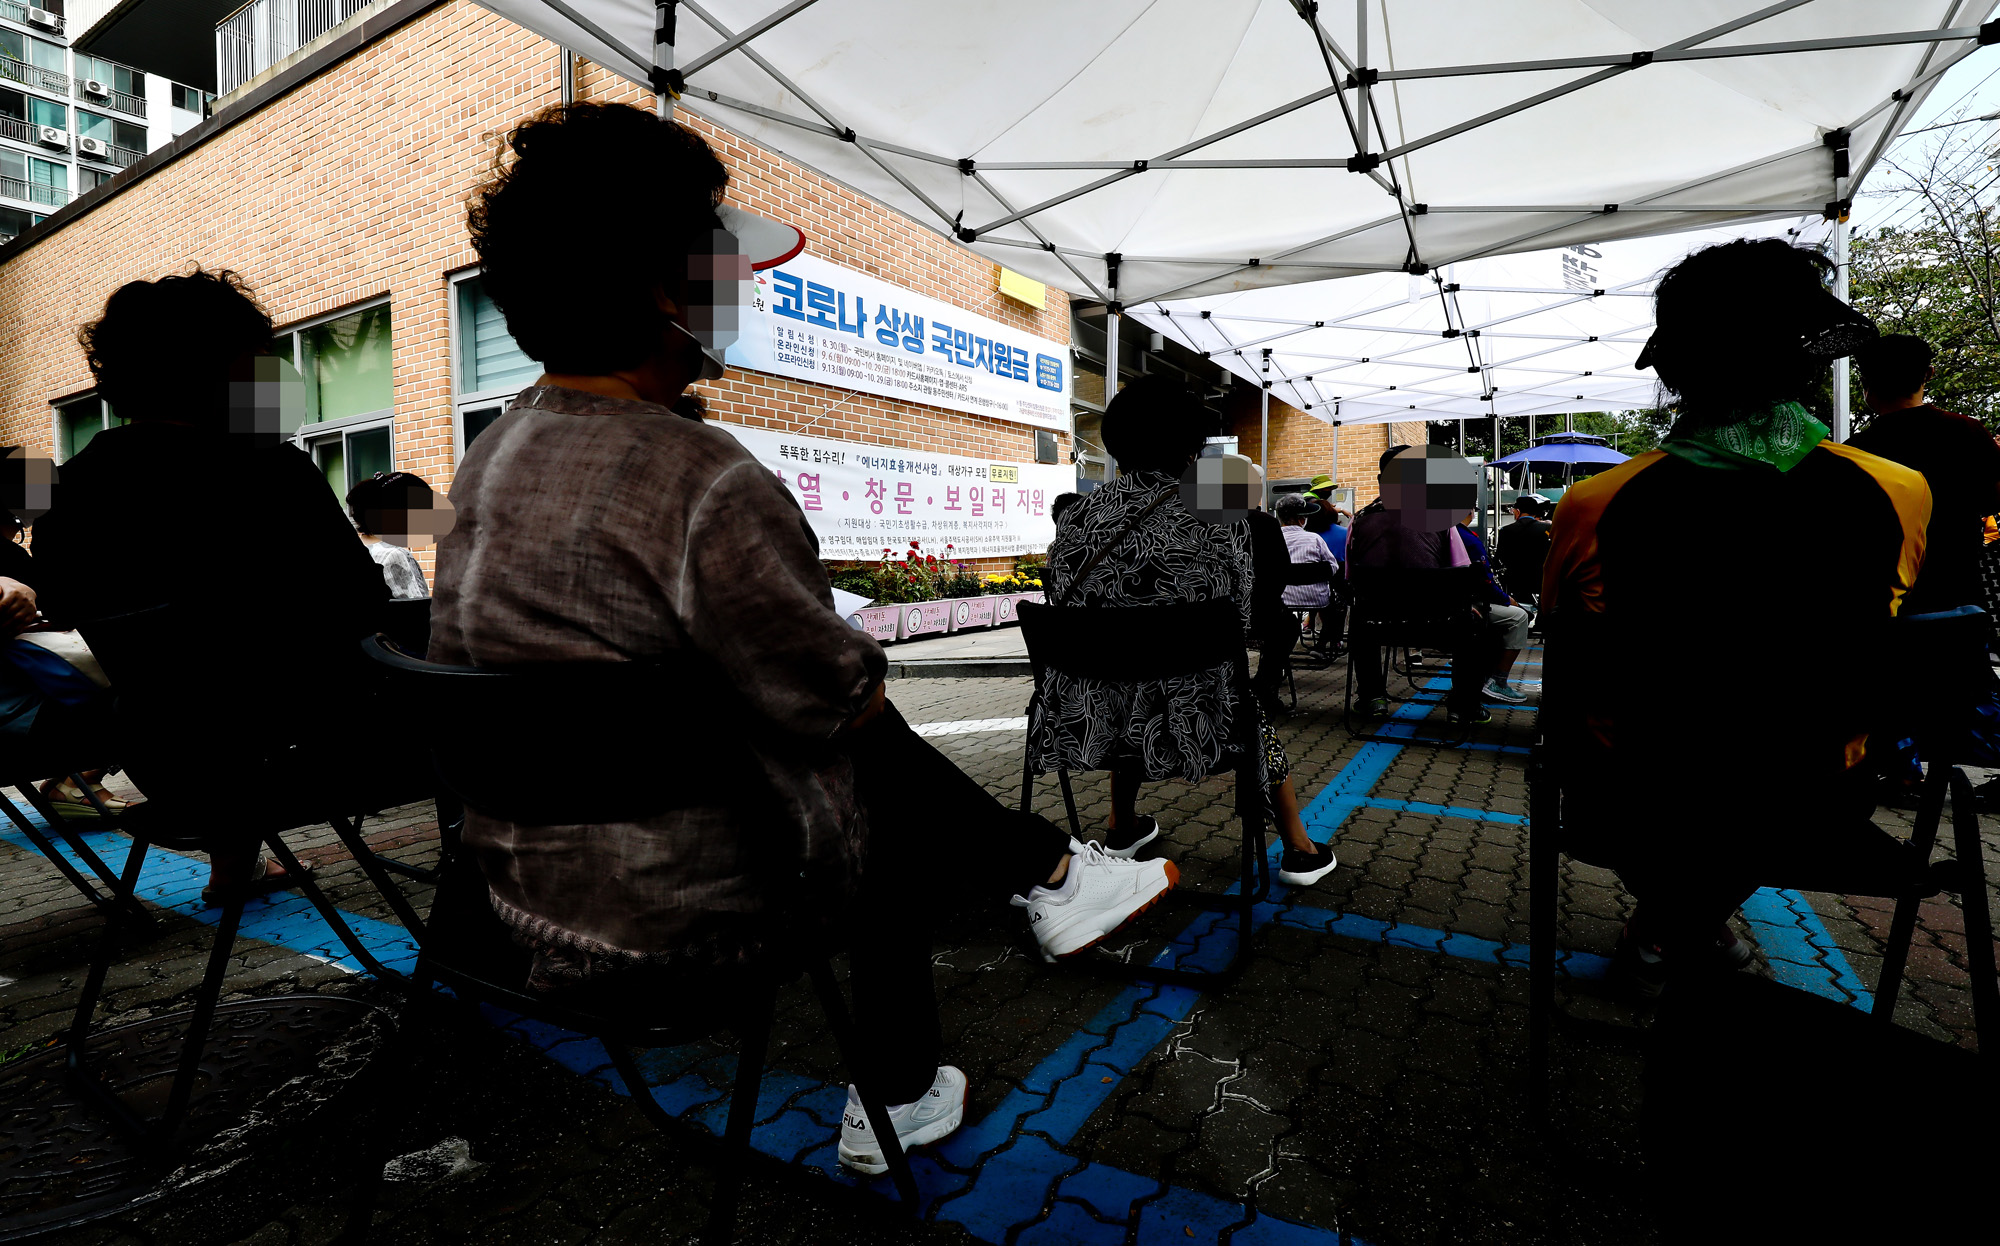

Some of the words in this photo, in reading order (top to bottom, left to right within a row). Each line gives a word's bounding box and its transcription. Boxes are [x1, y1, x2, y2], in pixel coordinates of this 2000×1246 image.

[773, 269, 867, 339] 코로나
[874, 304, 924, 354] 상생
[932, 321, 1029, 383] 국민지원금
[777, 339, 814, 357] 온라인신청
[845, 356, 861, 367] 09:00
[892, 368, 906, 378] 18:00
[876, 352, 896, 365] 홈페이지
[926, 365, 944, 377] 카카오톡
[778, 352, 815, 370] 오프라인신청
[847, 368, 863, 379] 09:00
[894, 379, 908, 389] 18:00
[780, 445, 809, 461] 똑똑한
[813, 449, 845, 465] 집수리!
[948, 465, 973, 478] 대상가구
[975, 467, 987, 478] 모집
[992, 468, 1017, 480] 무료지원!
[865, 477, 914, 515] 창문
[944, 486, 1005, 516] 보일러
[1017, 489, 1044, 516] 지원
[844, 518, 871, 529] 지원대상
[963, 520, 992, 530] 복지사각지대
[878, 624, 895, 633] 자치회
[929, 1089, 940, 1098] FILA
[843, 1113, 866, 1130] FILA
[932, 1120, 960, 1138] FILA
